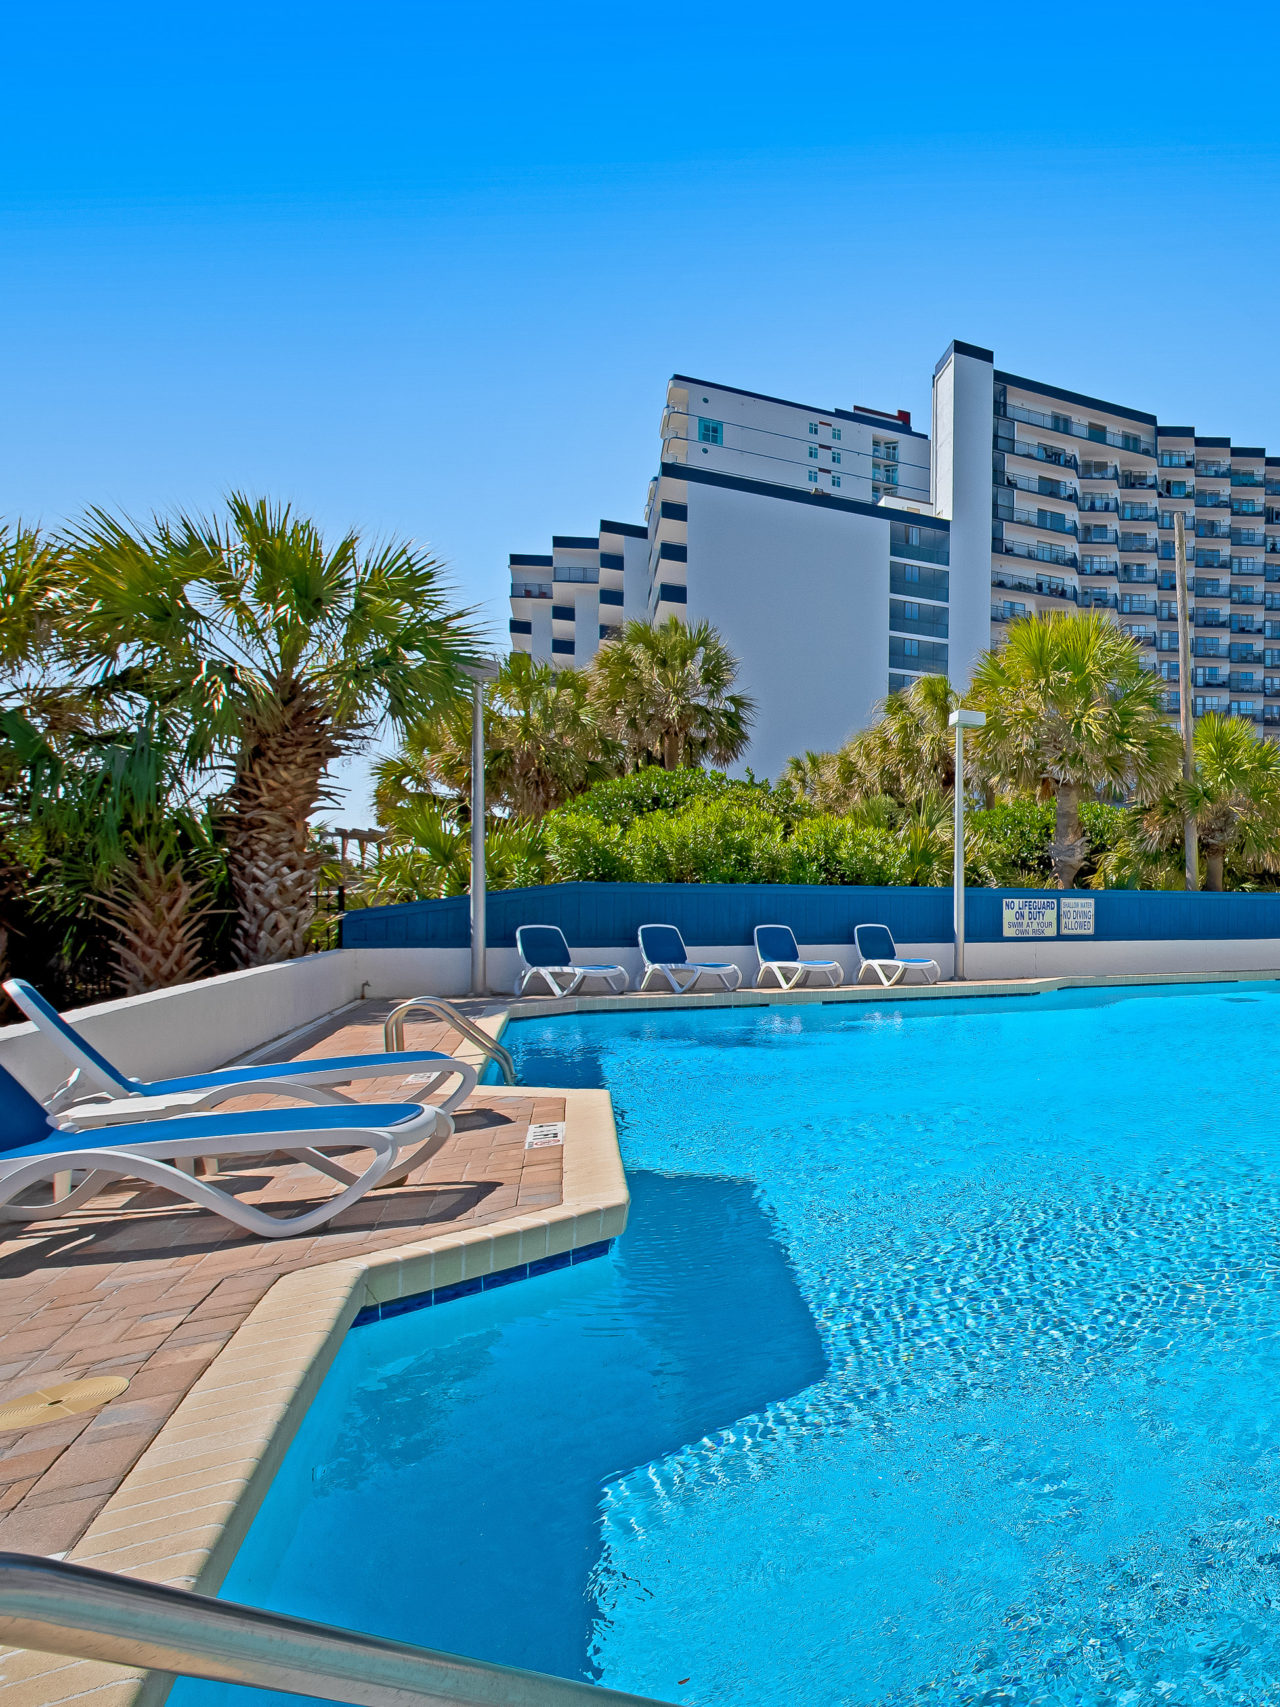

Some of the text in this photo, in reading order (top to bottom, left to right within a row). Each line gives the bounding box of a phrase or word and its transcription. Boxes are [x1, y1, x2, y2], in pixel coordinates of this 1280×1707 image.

[1005, 901, 1055, 910] NO LIFEGUARD
[1015, 911, 1045, 920] ON DUTY
[1063, 910, 1091, 919] NO DIVING
[1064, 921, 1091, 930] ALLOWED
